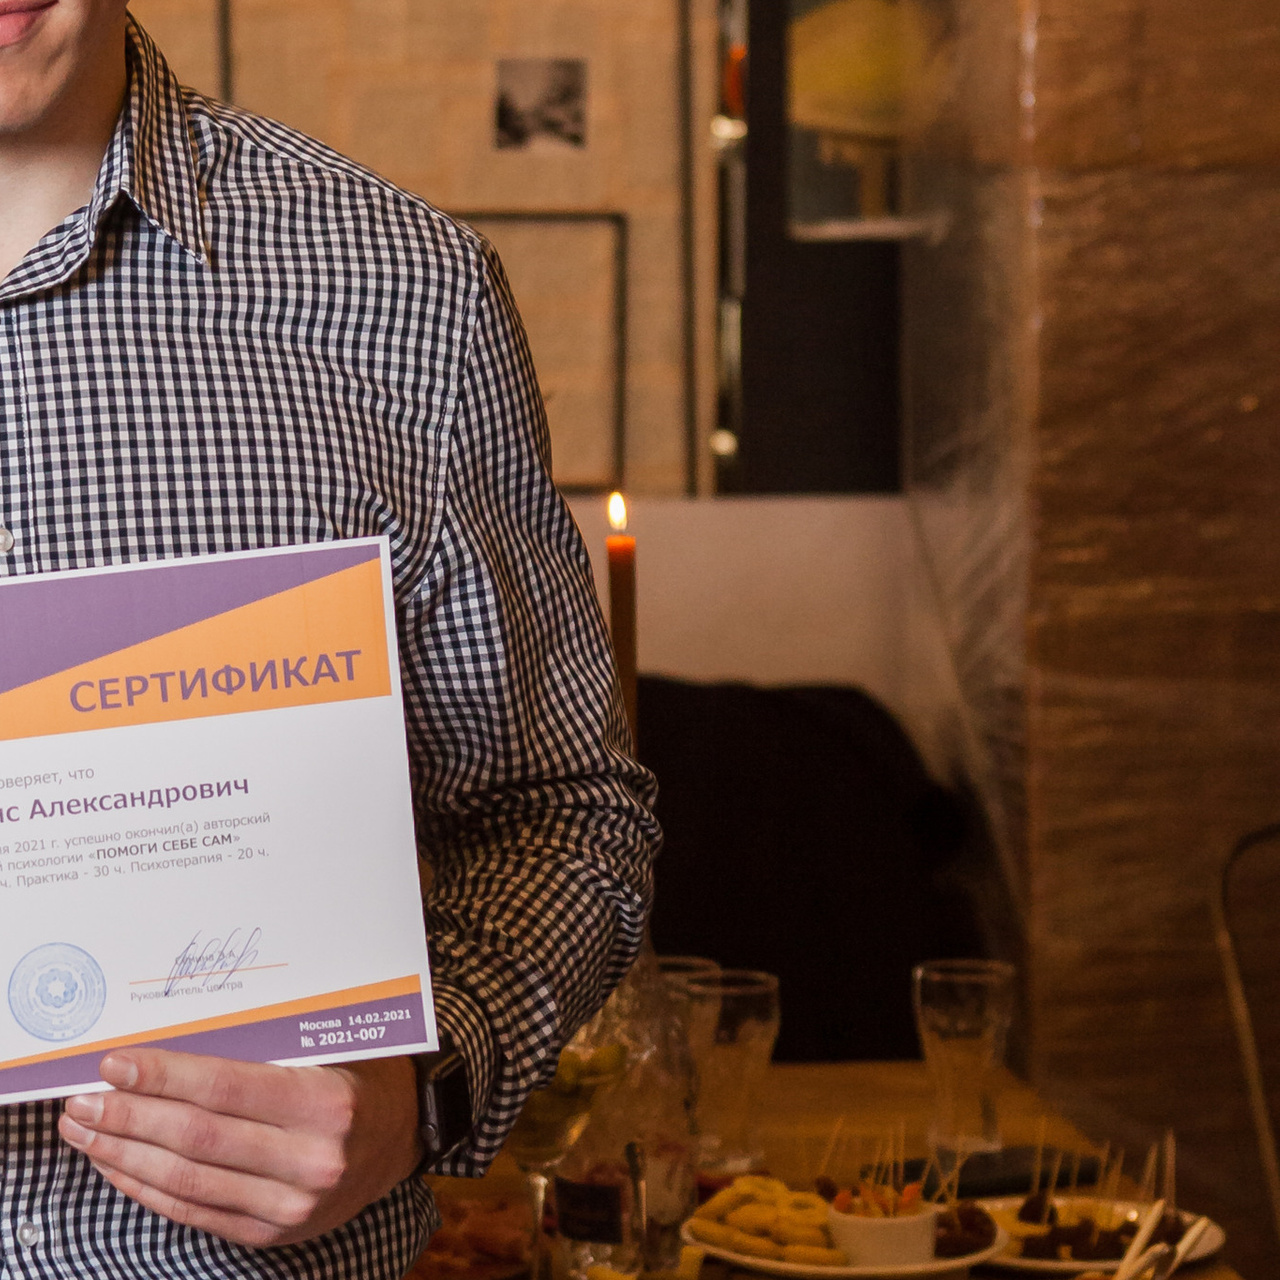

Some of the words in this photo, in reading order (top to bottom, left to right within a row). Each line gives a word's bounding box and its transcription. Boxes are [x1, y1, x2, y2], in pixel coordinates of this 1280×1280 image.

[70, 650, 362, 713] СЕРТИФИКАТ
[68, 768, 94, 780] что
[29, 778, 249, 819] Александрович
[7, 853, 83, 872] психологии
[89, 843, 158, 860] «ПОМОГИ
[163, 837, 197, 851] СЕБЕ
[202, 833, 241, 847] САМ»
[14, 837, 45, 854] 2021
[51, 839, 59, 849] г.
[64, 832, 121, 849] успешно
[125, 820, 199, 840] окончил(а)
[203, 812, 271, 832] авторский
[0, 879, 11, 889] ч.
[17, 871, 78, 888] Практика
[94, 865, 109, 878] 30
[114, 865, 125, 874] ч.
[131, 853, 223, 874] Психотерапия
[238, 848, 253, 860] 20
[258, 848, 270, 858] ч.
[300, 1019, 342, 1032] Москва
[348, 1009, 411, 1026] 14.02.2021
[319, 1026, 386, 1046] 2021-007
